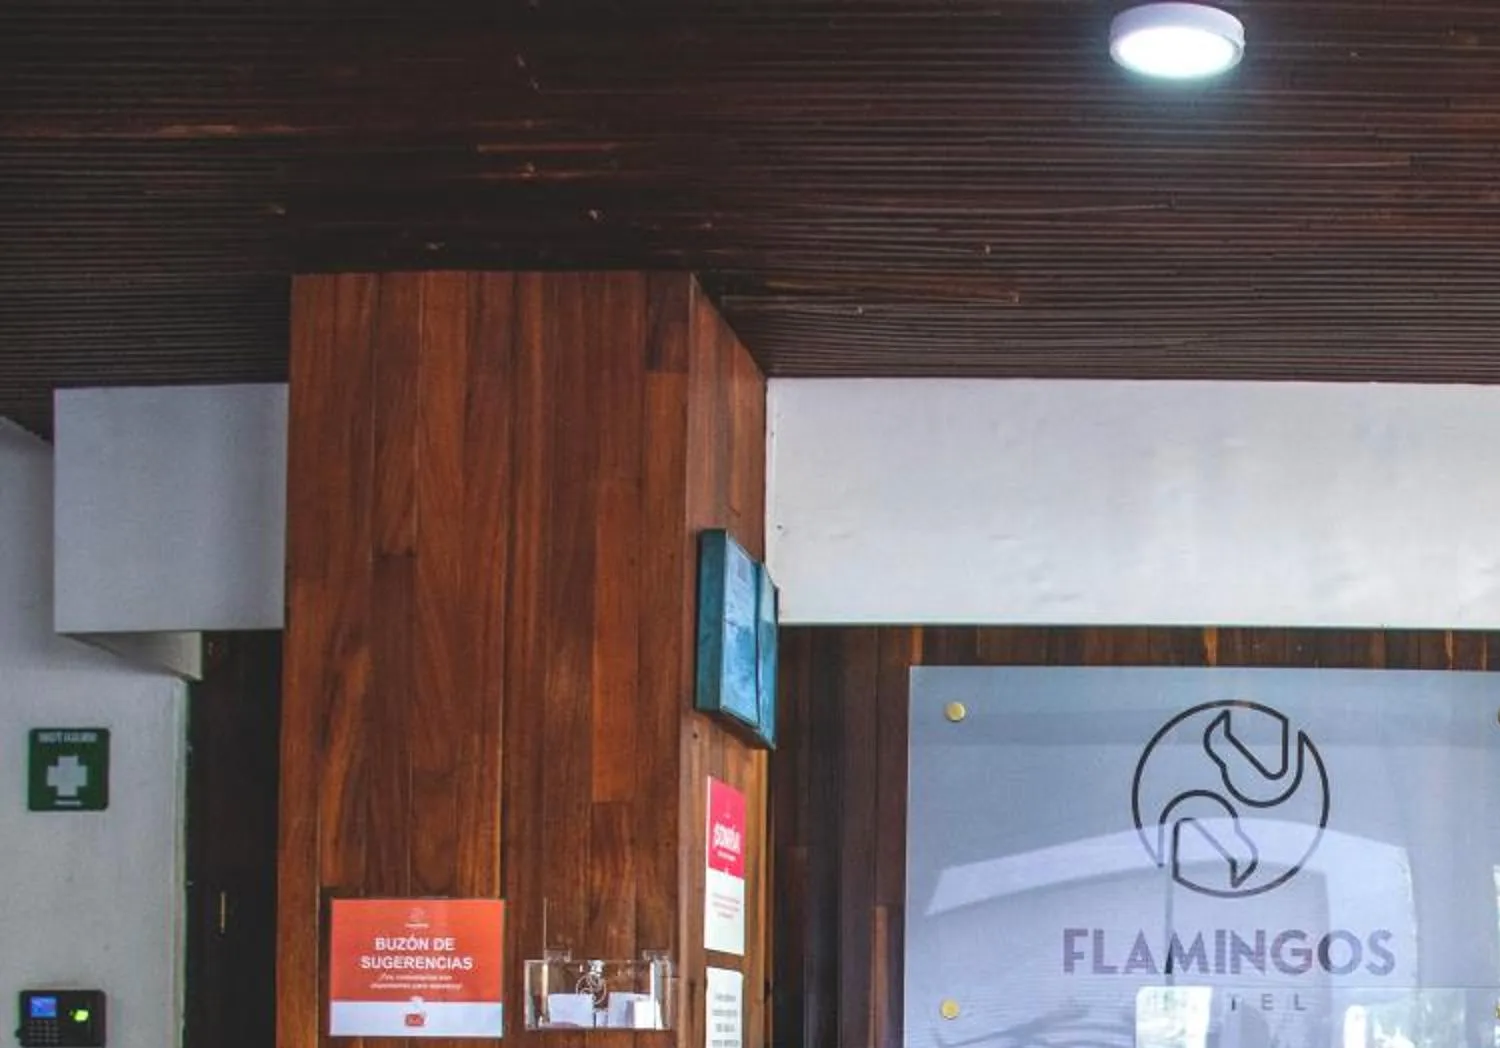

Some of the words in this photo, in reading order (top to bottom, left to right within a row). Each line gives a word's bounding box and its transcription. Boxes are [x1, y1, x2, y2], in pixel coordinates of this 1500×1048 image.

[375, 935, 429, 951] BUZÓN
[433, 937, 456, 951] DE
[1063, 928, 1396, 976] FLAMINGOS
[361, 956, 473, 969] SUGERENCIAS
[1226, 993, 1307, 1011] TEL
